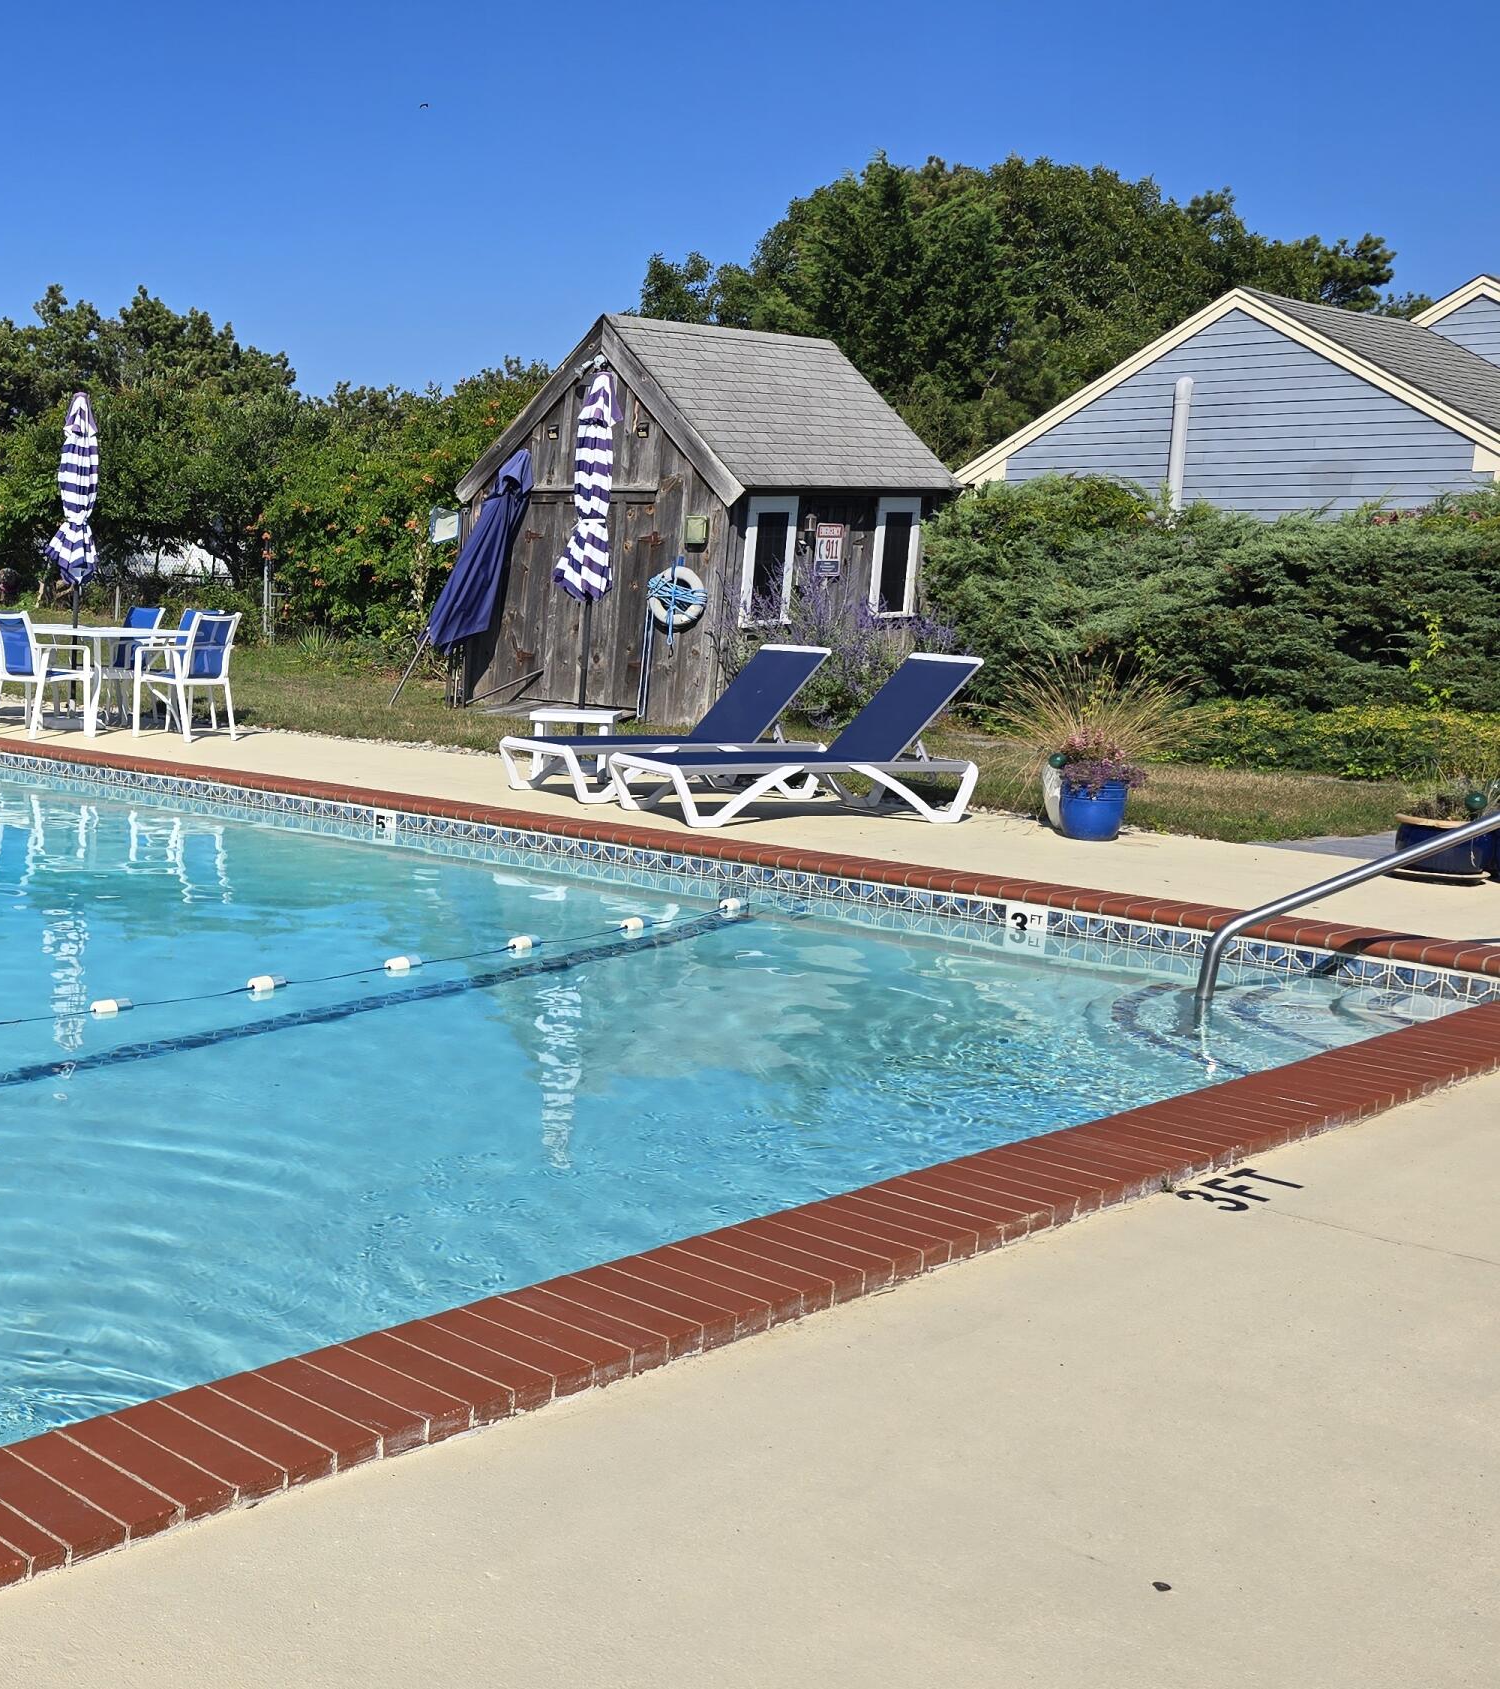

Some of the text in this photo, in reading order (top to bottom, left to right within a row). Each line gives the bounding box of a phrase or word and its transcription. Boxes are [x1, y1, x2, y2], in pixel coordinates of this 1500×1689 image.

[825, 539, 839, 559] 911
[376, 814, 386, 829] 5
[1011, 912, 1044, 931] 3 FT
[1175, 1168, 1304, 1212] 3FT
